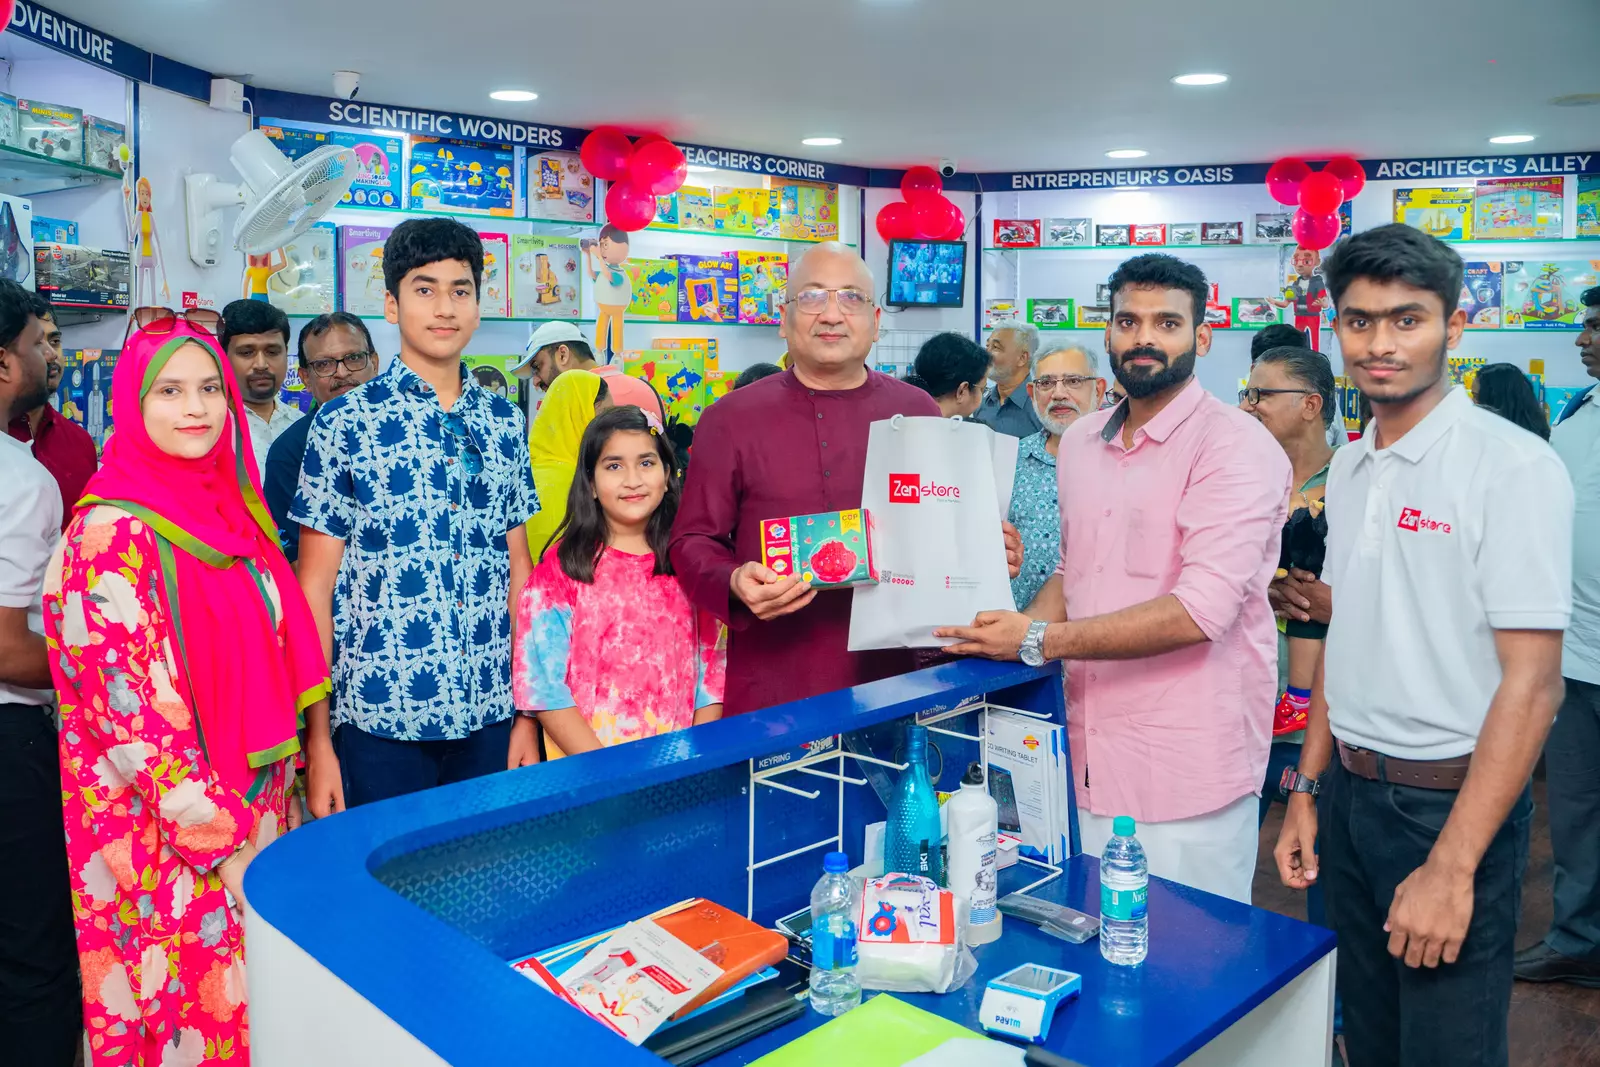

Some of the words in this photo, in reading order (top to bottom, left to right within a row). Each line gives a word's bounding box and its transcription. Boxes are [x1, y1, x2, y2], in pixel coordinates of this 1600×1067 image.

[11, 1, 114, 65] DVENTURE
[328, 101, 453, 133] SCIENTIFIC
[458, 117, 563, 147] WONDERS
[765, 158, 825, 180] CORNER
[1376, 157, 1517, 178] ARCHITECT'S
[1522, 155, 1592, 173] ALLEY
[1012, 169, 1170, 189] ENTREPRENEUR'S
[1174, 167, 1234, 184] OASIS
[697, 260, 719, 270] GLOW
[719, 262, 734, 271] ART
[758, 752, 791, 768] KEYRING
[994, 744, 1017, 757] WRITING
[1017, 752, 1038, 764] TABLET
